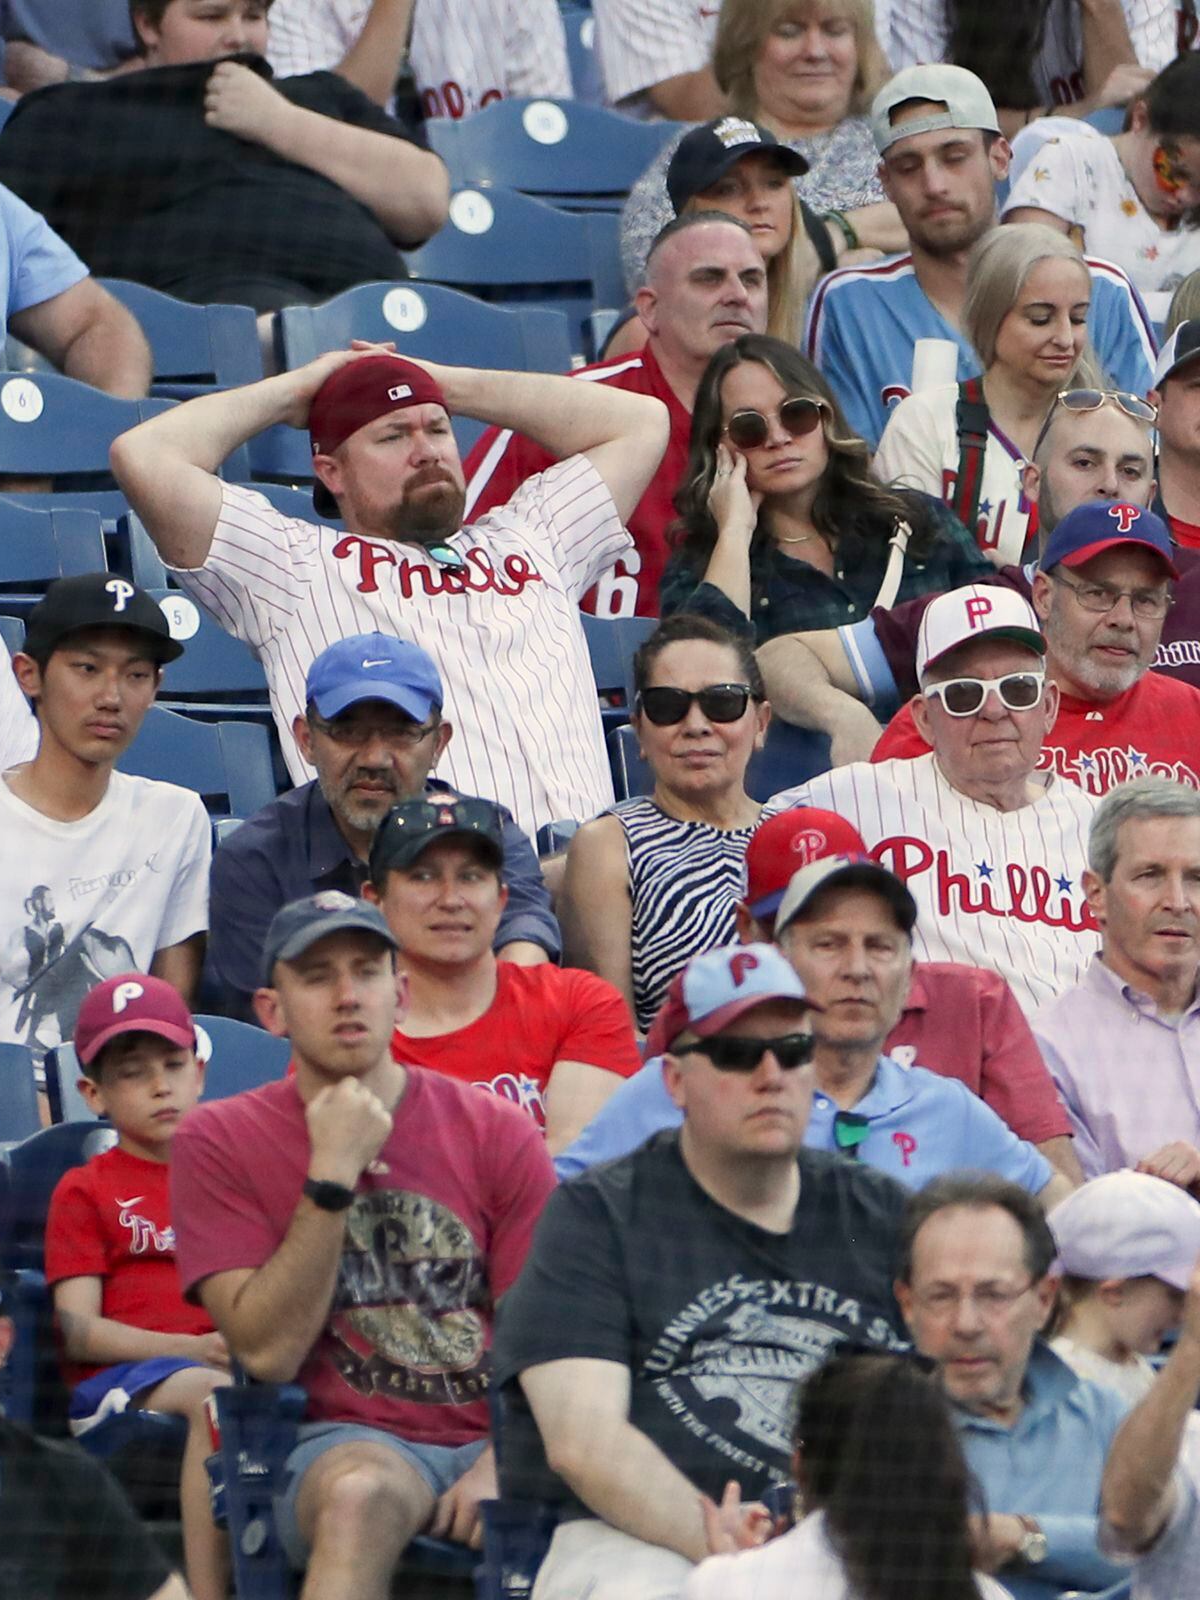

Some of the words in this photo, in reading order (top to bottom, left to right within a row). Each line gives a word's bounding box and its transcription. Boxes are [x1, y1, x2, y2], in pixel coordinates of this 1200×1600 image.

[18, 394, 26, 408] 6
[1107, 503, 1141, 533] P
[104, 579, 135, 612] P
[173, 610, 182, 625] 5
[965, 596, 993, 630] P
[791, 829, 827, 866] P
[729, 952, 759, 989] P
[112, 981, 144, 1014] P
[891, 1132, 916, 1168] P
[642, 1273, 751, 1375] UINNESS
[751, 1278, 863, 1325] EXTRA
